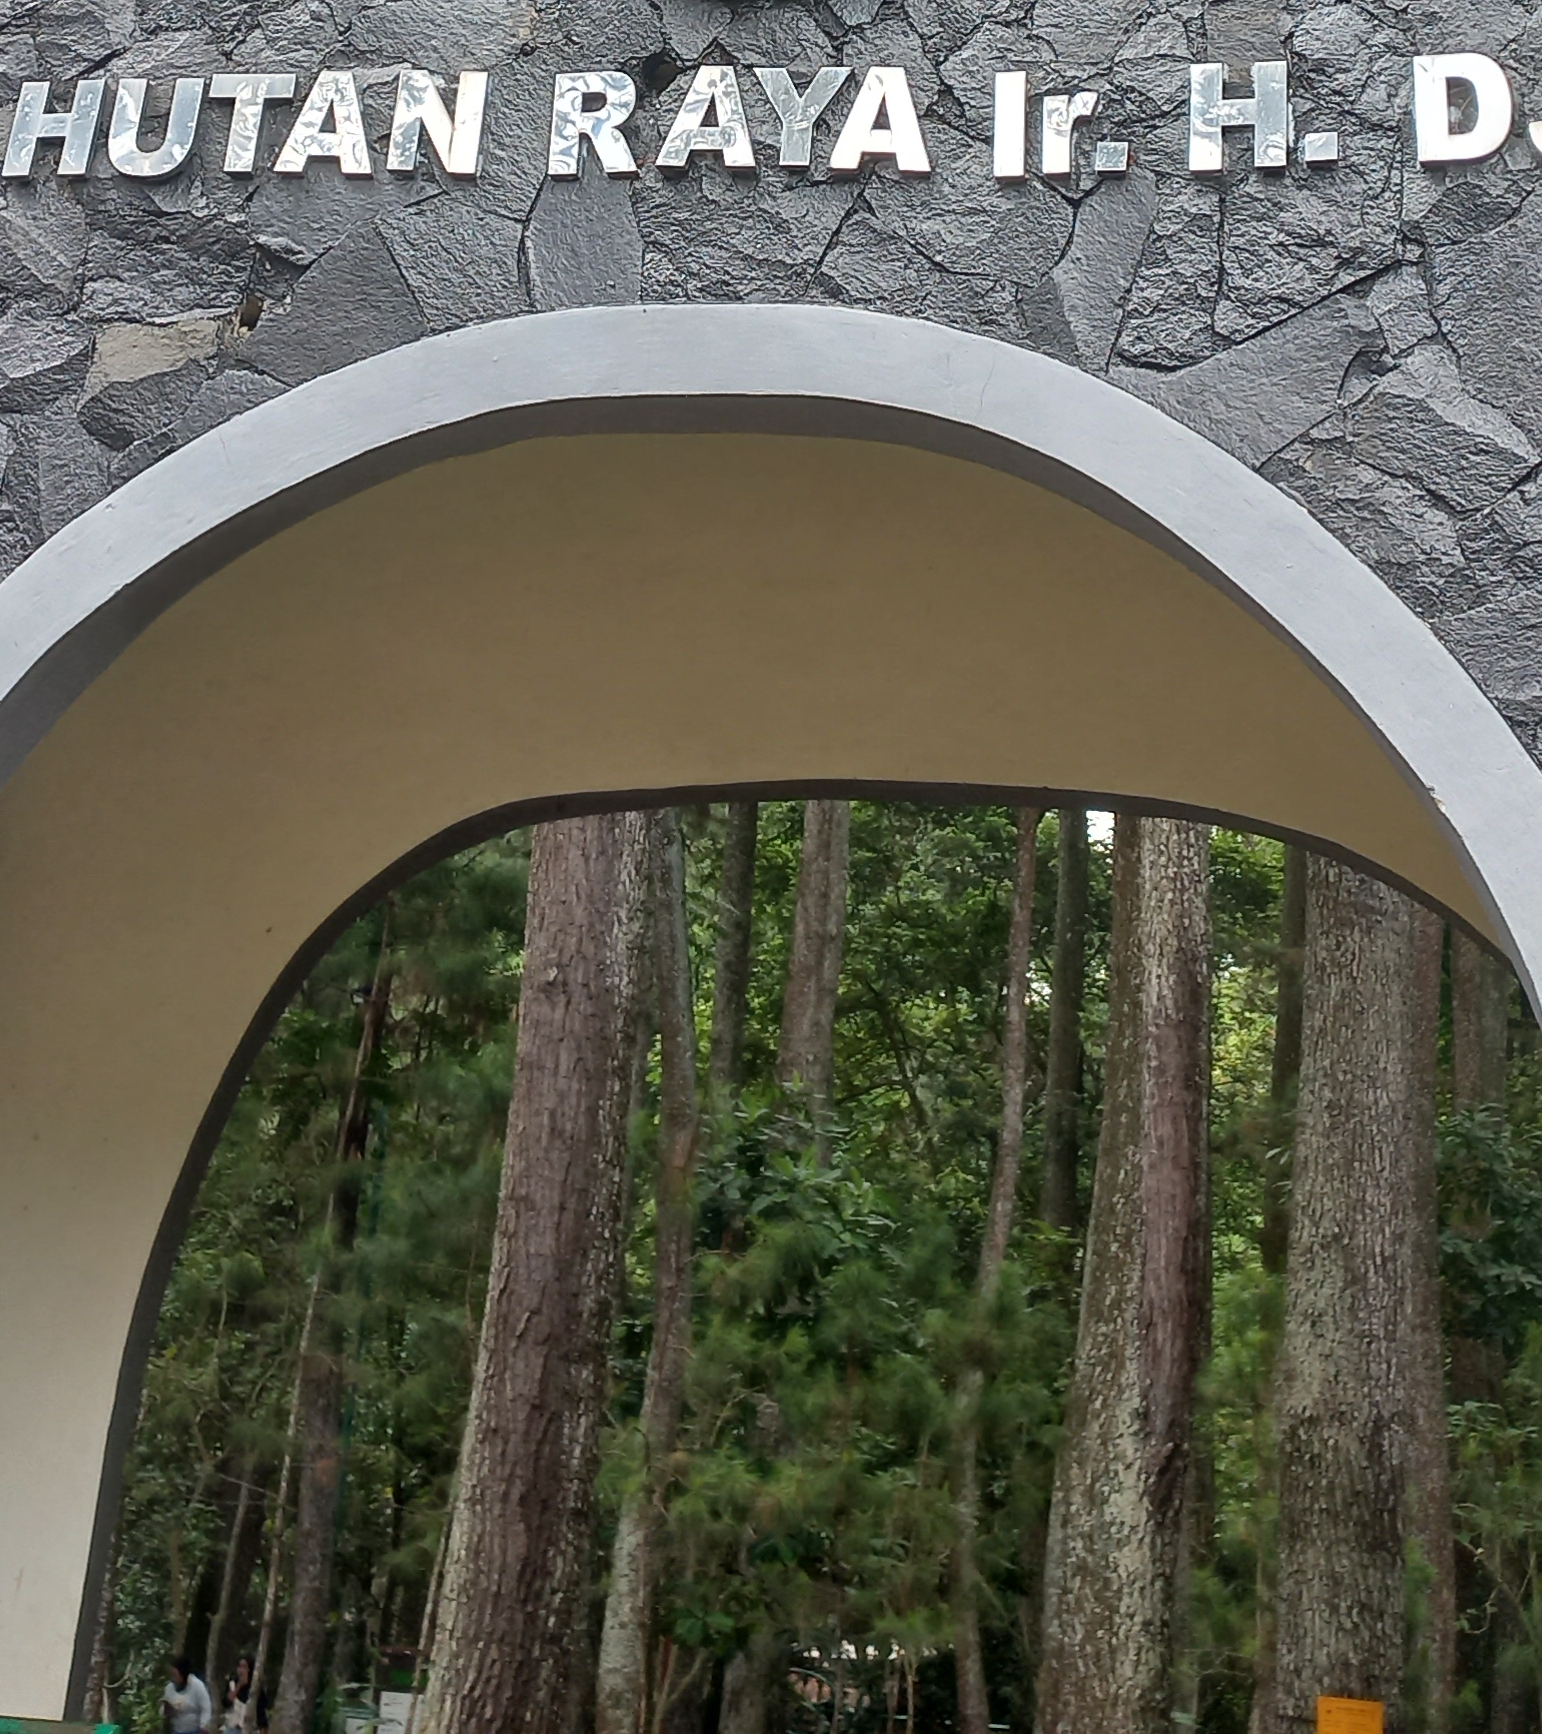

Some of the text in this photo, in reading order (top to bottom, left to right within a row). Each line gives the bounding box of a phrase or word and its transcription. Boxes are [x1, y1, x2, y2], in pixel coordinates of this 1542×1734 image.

[2, 69, 490, 182] HUTAN
[546, 67, 932, 180] RAYA
[989, 70, 1128, 181] Ir.
[1188, 61, 1341, 177] H.
